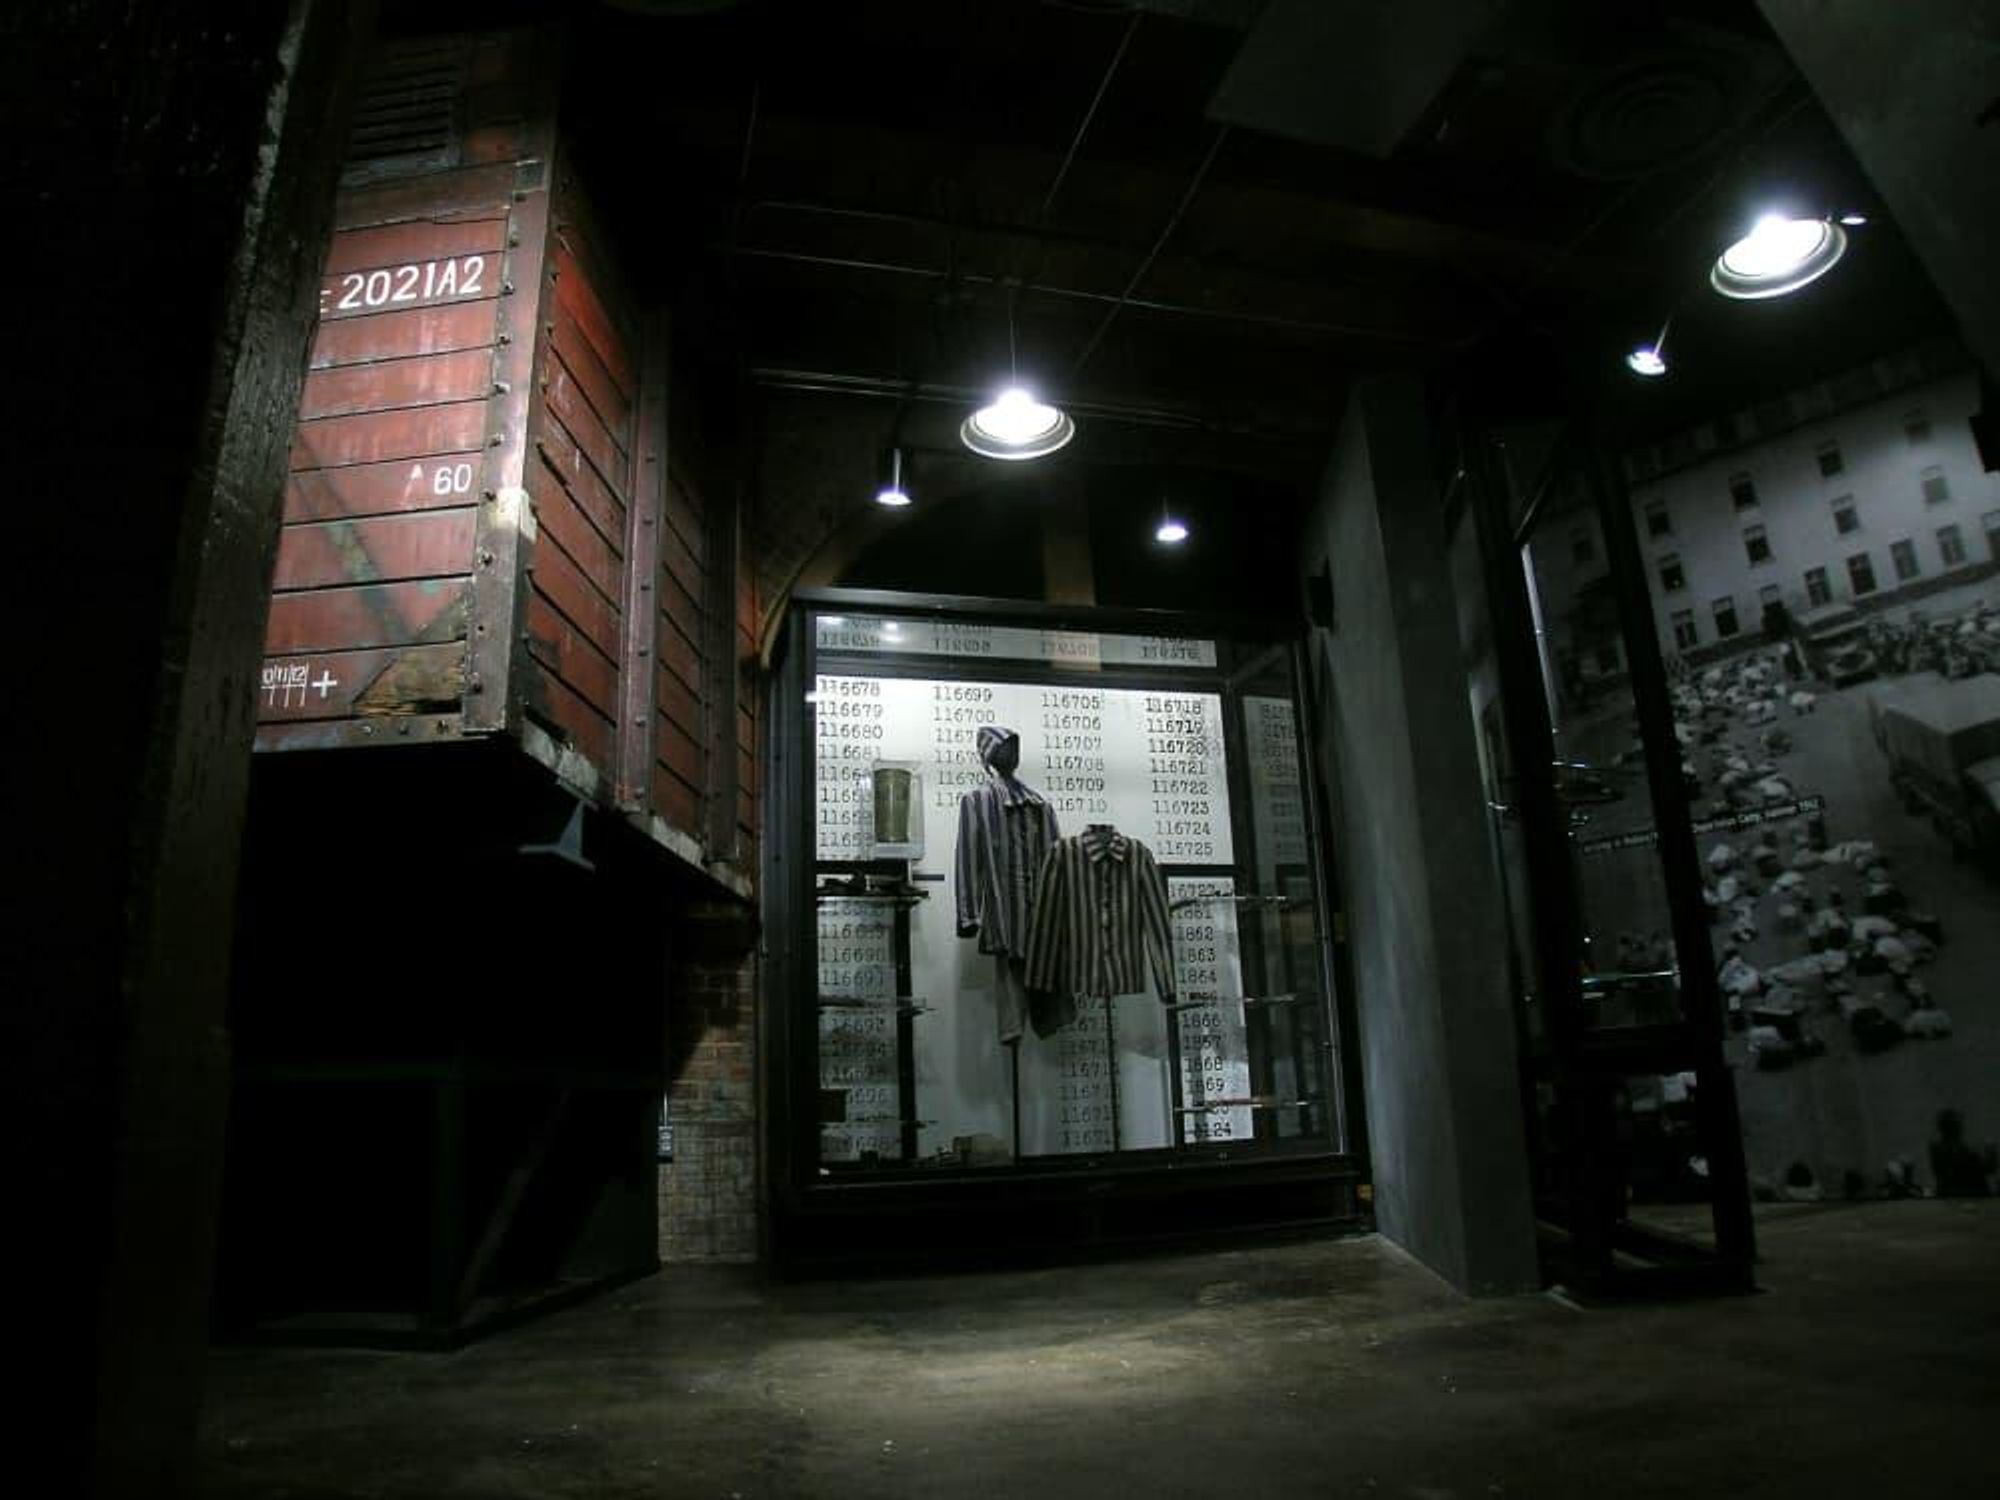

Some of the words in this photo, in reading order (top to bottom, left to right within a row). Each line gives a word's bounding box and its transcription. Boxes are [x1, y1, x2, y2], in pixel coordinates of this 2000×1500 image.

[433, 464, 472, 494] 60
[932, 686, 993, 702] 116699
[1041, 693, 1101, 710] 116705
[817, 701, 884, 718] 116679
[933, 707, 996, 725] 116700
[818, 721, 884, 739] 116680
[1042, 713, 1102, 731] 116706
[936, 727, 976, 744] 1167
[1042, 735, 1102, 752] 116707
[1150, 759, 1206, 776] 116721
[1046, 776, 1105, 793] 116709
[1151, 779, 1208, 796] 116722
[1052, 798, 1108, 814] 16710
[1153, 799, 1210, 816] 116723
[1155, 820, 1212, 837] 116724
[1176, 925, 1215, 942] 1862
[1179, 947, 1217, 963] 1863
[1180, 969, 1218, 985] 1864
